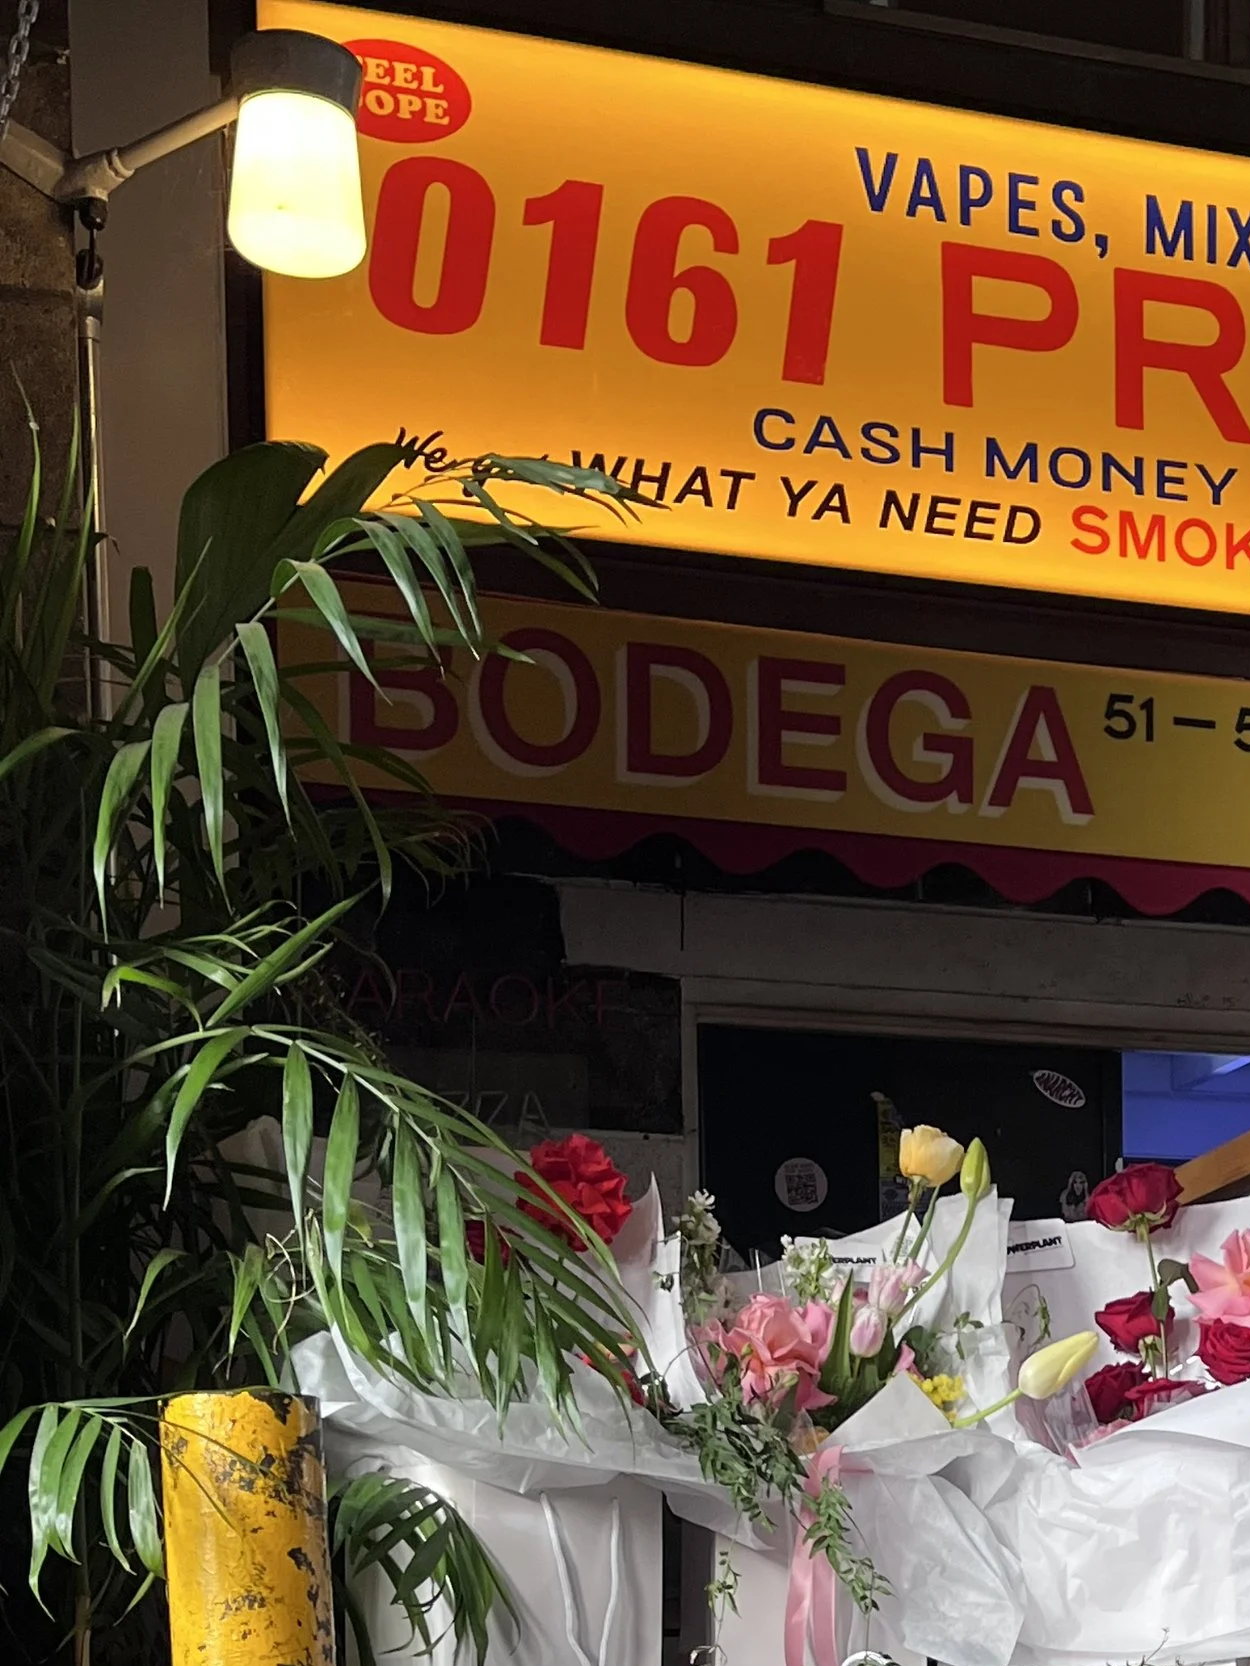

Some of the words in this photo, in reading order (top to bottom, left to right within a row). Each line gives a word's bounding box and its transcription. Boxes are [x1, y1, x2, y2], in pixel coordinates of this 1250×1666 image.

[355, 55, 444, 94] EEL
[359, 89, 450, 125] OPE
[856, 147, 1109, 258] VAPES,
[368, 156, 844, 386] 0161
[571, 450, 756, 511] WHAT
[779, 476, 852, 525] YA
[879, 490, 1042, 545] NEED
[752, 408, 956, 474] CASH
[984, 437, 1239, 506] MONEY
[338, 611, 1095, 825] BODEGA
[346, 966, 632, 1030] ARAOKE
